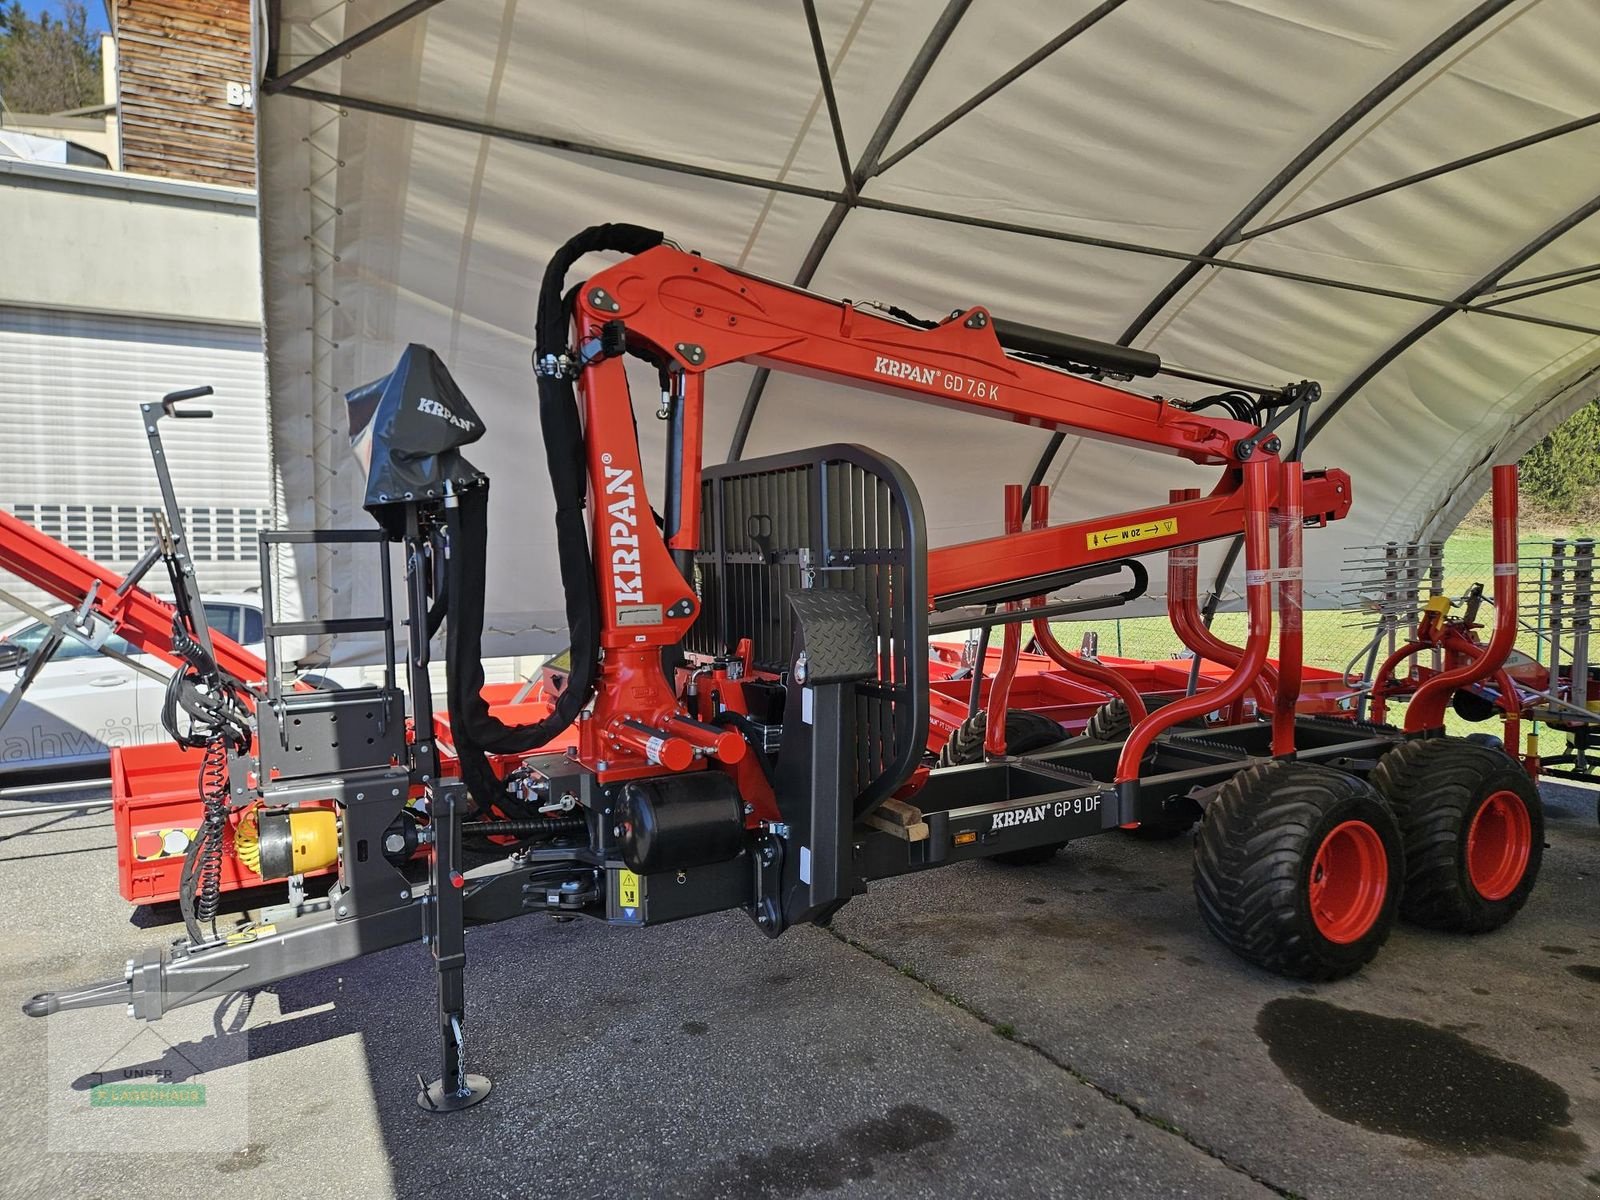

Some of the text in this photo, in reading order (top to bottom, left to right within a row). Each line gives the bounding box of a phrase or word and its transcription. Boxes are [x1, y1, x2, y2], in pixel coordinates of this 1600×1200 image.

[944, 374, 963, 392] GD
[967, 379, 986, 398] 7,6
[990, 385, 999, 400] K
[1121, 528, 1141, 539] 20 M
[1054, 801, 1071, 818] GP
[1073, 799, 1082, 814] 9
[1085, 795, 1101, 812] DF
